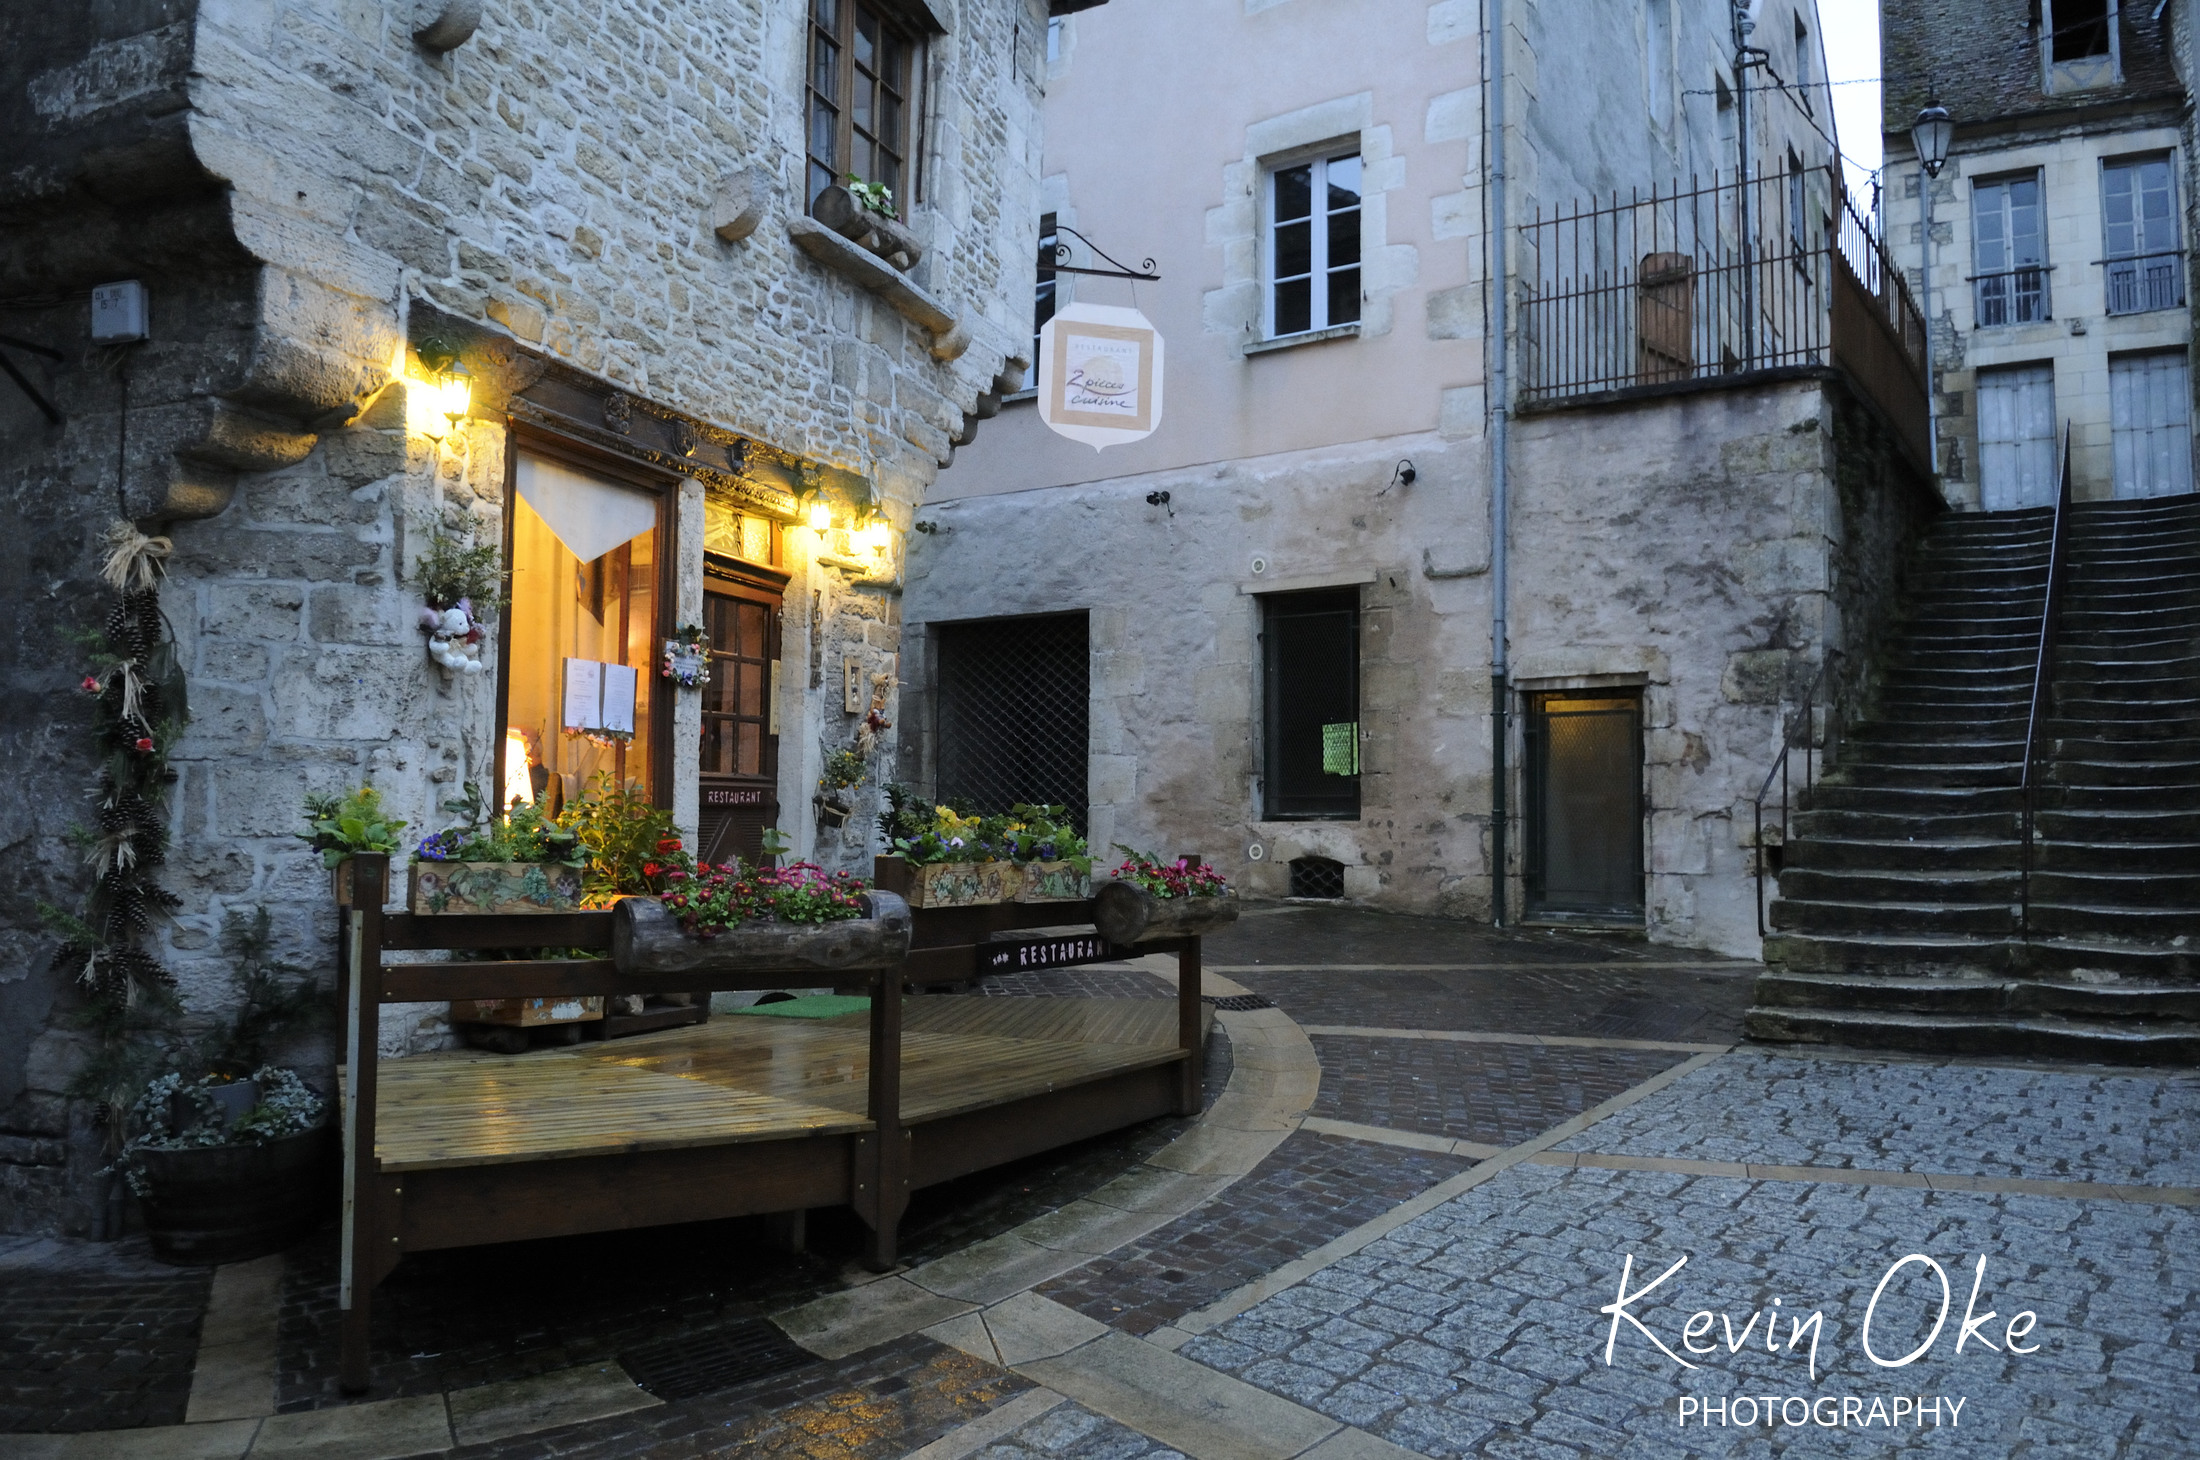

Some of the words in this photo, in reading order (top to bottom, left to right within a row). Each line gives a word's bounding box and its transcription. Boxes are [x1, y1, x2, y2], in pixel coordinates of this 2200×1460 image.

[1066, 369, 1085, 387] 2
[1071, 395, 1135, 408] cuisine
[708, 790, 761, 804] RESTAURANT
